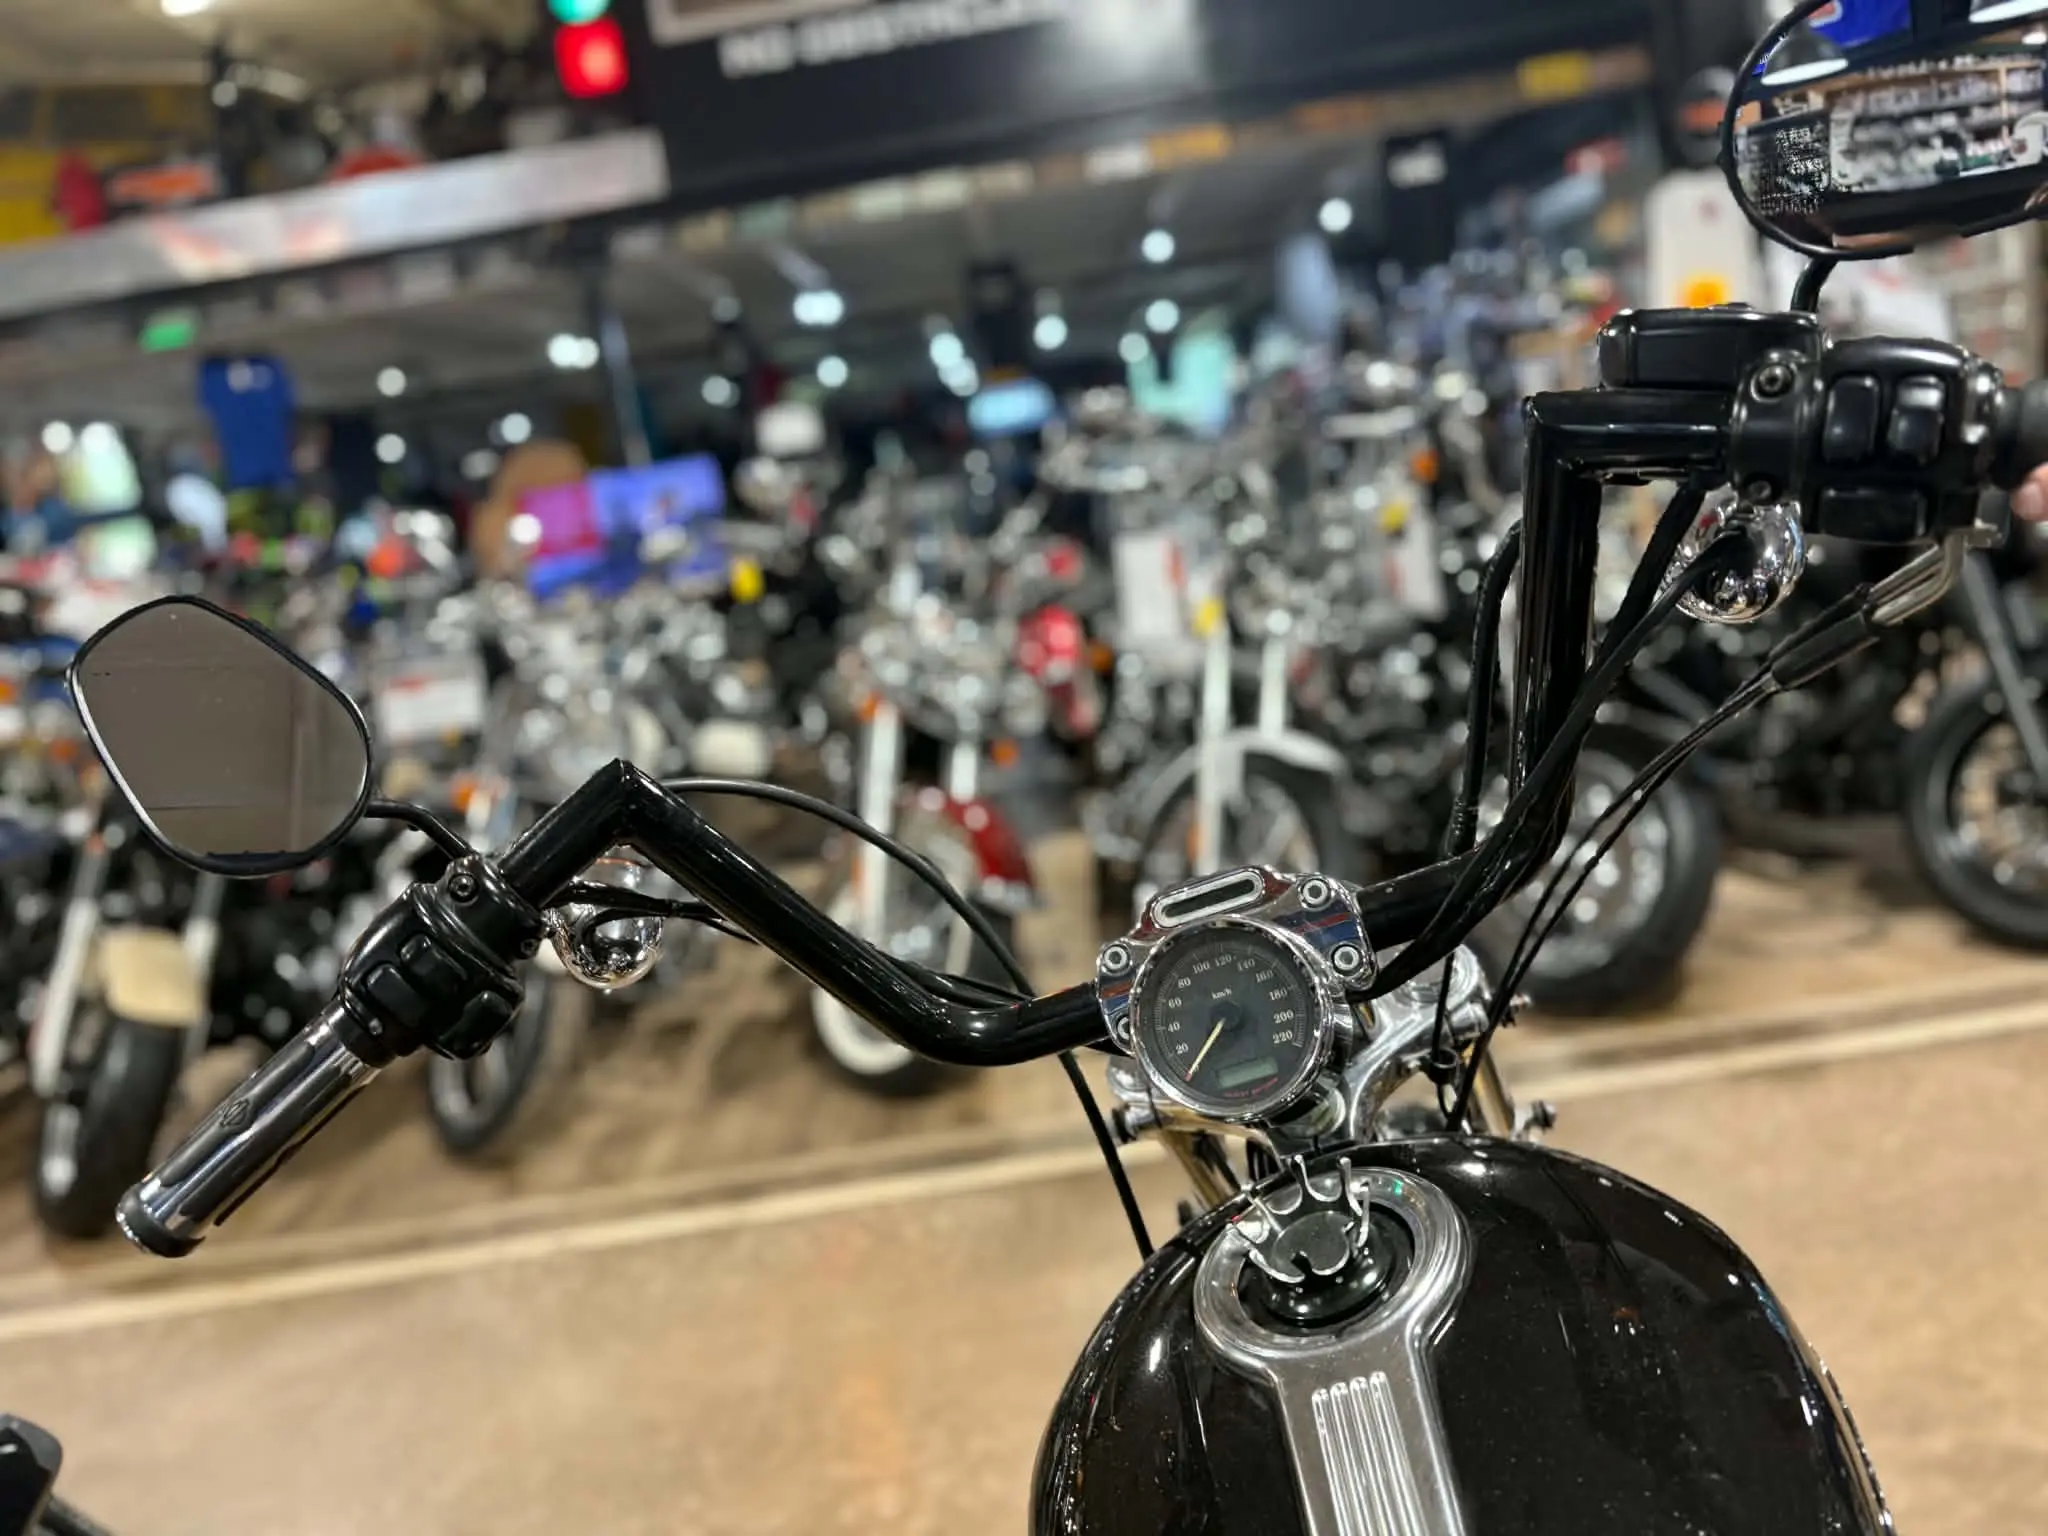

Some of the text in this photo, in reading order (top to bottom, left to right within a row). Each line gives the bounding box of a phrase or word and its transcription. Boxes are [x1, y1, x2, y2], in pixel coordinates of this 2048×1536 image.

[1215, 954, 1233, 967] 120
[1237, 958, 1256, 971] 140
[1192, 961, 1210, 974] 100
[1255, 969, 1274, 983] 160
[1178, 977, 1191, 989] 80
[1268, 988, 1288, 1001] 180
[1168, 997, 1182, 1009] 60
[1273, 1010, 1294, 1024] 200
[1168, 1021, 1181, 1033] 40
[1272, 1030, 1293, 1045] 220
[1175, 1043, 1189, 1055] 20
